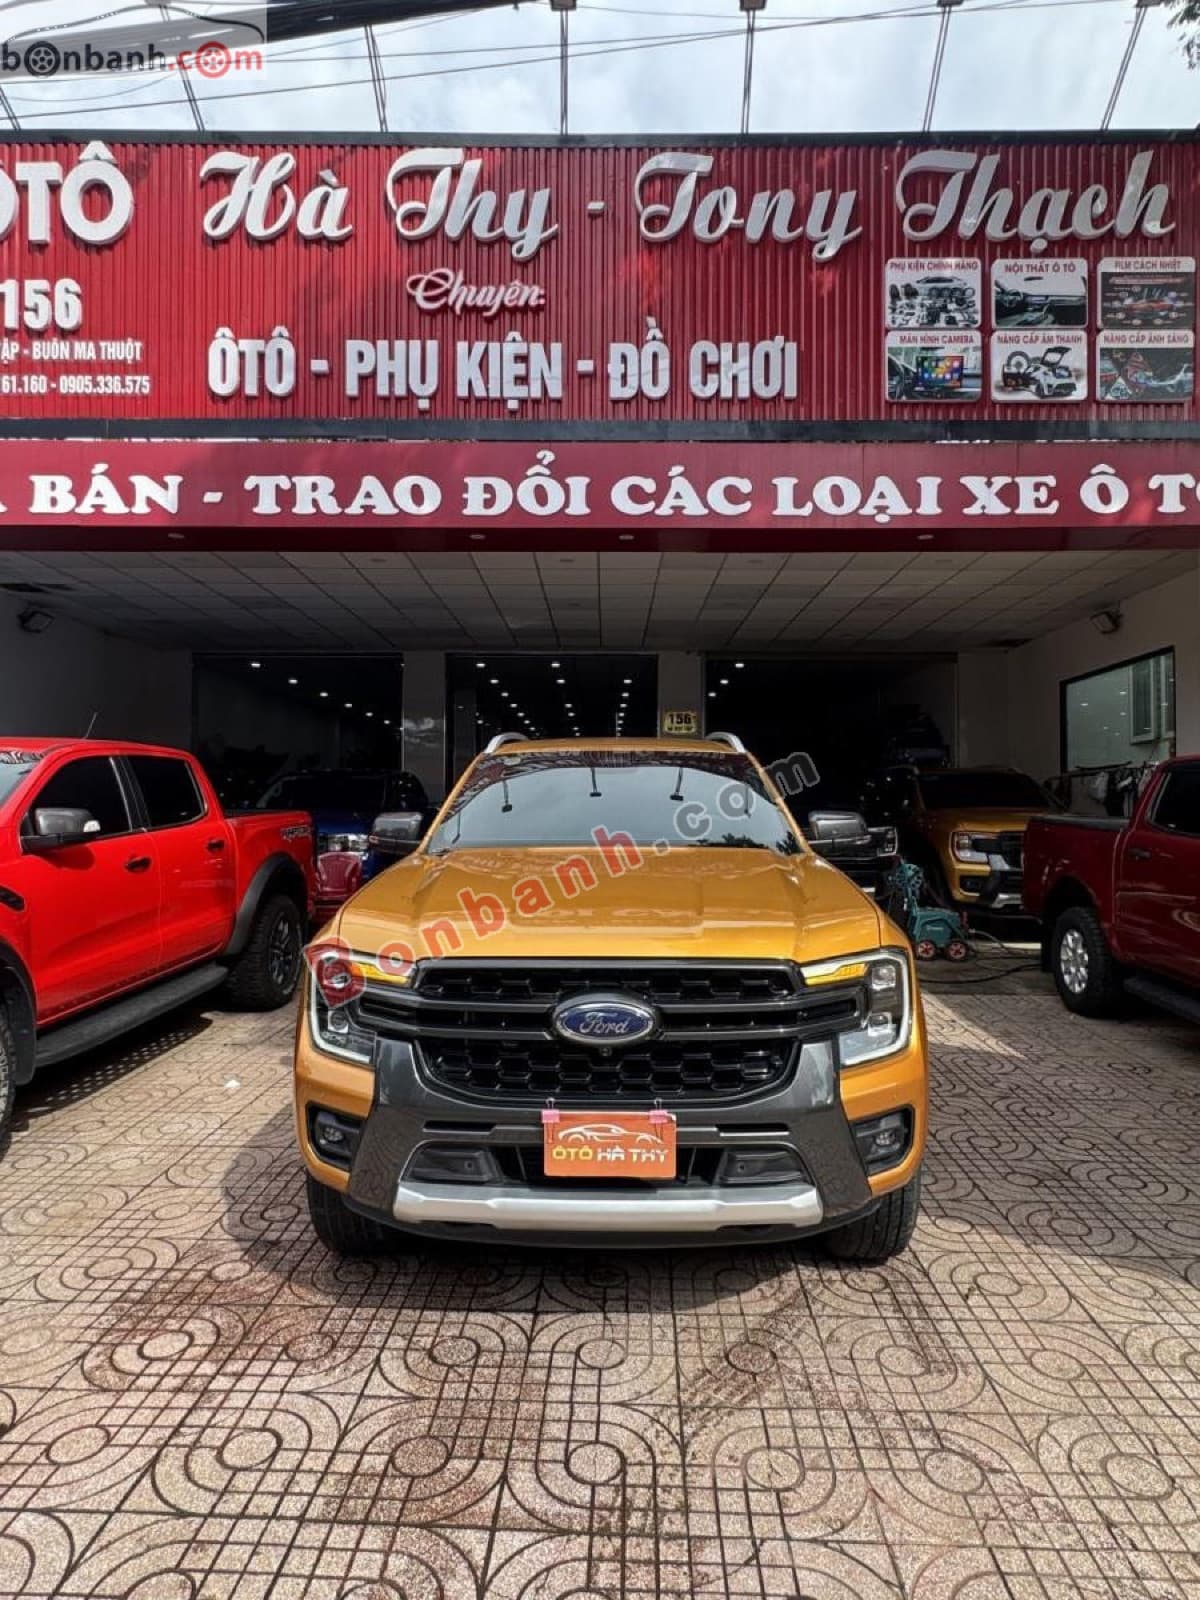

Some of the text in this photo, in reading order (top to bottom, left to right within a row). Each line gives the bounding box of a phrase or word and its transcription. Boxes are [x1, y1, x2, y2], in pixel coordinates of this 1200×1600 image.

[0, 141, 134, 245] TÔ
[199, 152, 352, 241] Hà
[386, 148, 558, 261] Thy
[634, 152, 862, 262] Tony
[896, 150, 1175, 253] Thạch
[0, 278, 82, 330] 156
[406, 267, 546, 317] Chuyên:
[32, 337, 70, 361] BUÔN
[74, 341, 97, 361] MA
[99, 336, 142, 364] THUỘT
[208, 326, 296, 397] ÔTÔ
[345, 340, 440, 410] PHỤ
[456, 331, 563, 411] KIỆN
[608, 316, 670, 400] ĐỒ
[689, 335, 798, 400] CHƠI
[59, 375, 150, 395] 0905.336.575
[29, 463, 183, 514] BÁN
[244, 474, 442, 515] TRAO
[463, 450, 590, 516] ĐỔI
[610, 464, 753, 516] CÁC
[772, 475, 942, 523] LOẠI
[959, 475, 1059, 516] XE
[1080, 463, 1129, 514] Ô
[1148, 473, 1200, 514] T
[579, 1011, 629, 1034] Ford
[629, 1148, 669, 1162] THY
